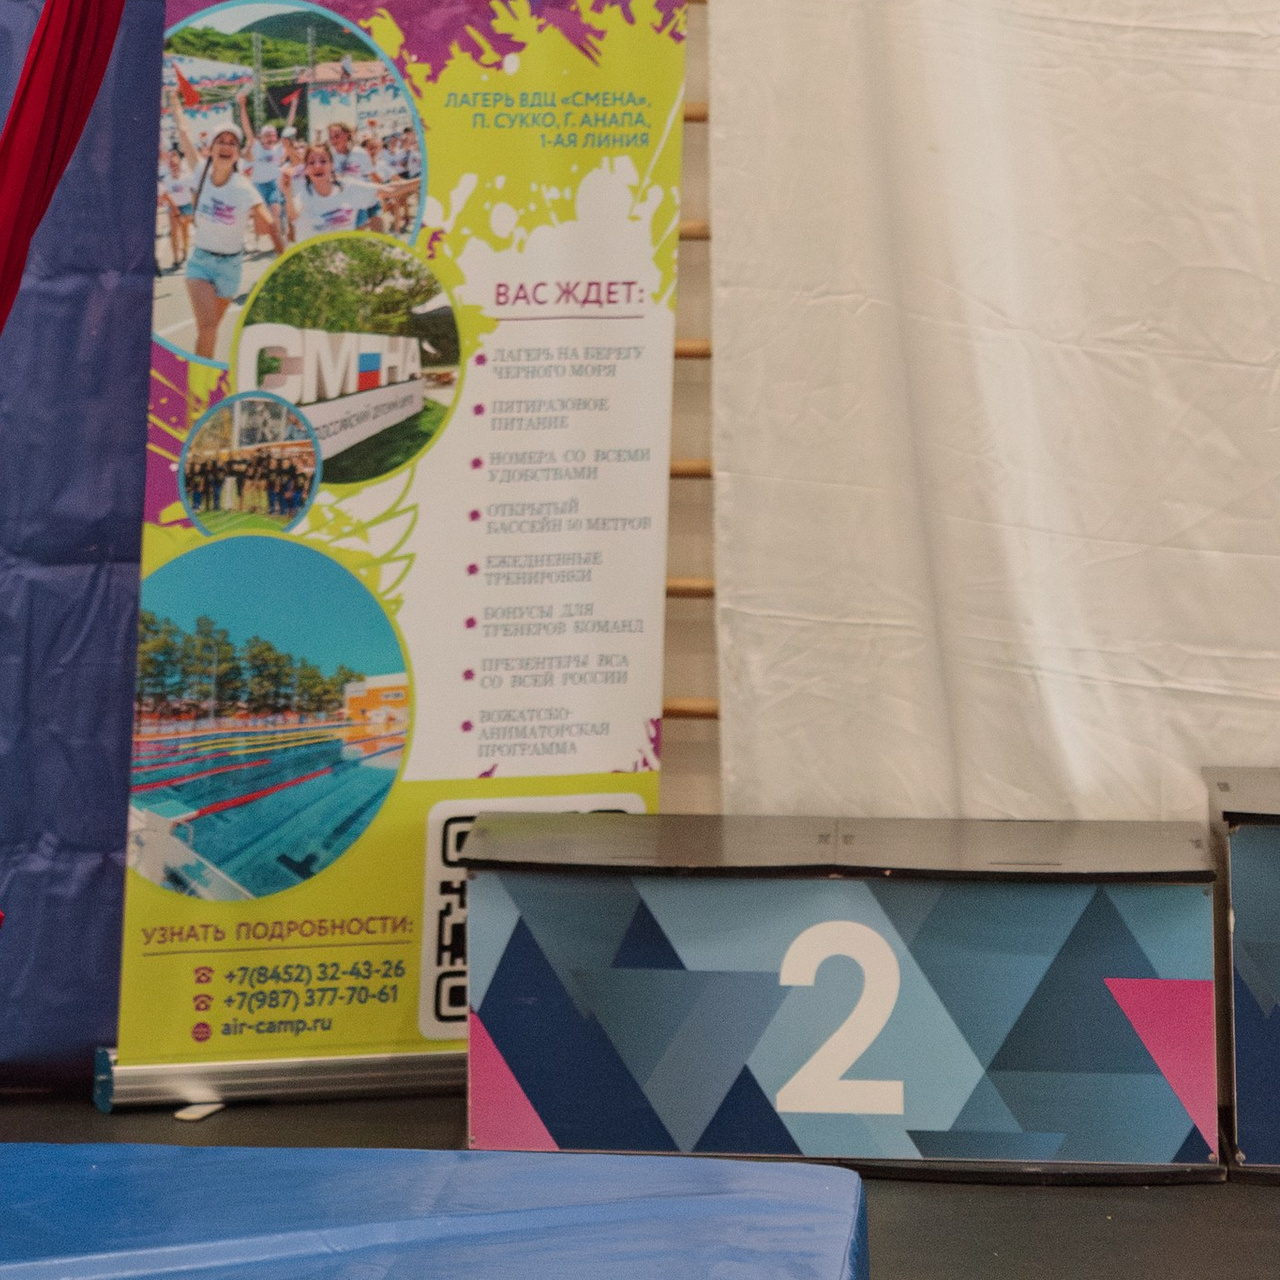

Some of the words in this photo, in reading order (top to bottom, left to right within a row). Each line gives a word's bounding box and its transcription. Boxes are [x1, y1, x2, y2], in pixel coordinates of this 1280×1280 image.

[444, 92, 515, 108] ЛАГЕРЬ
[520, 92, 556, 109] ВДЦ
[561, 91, 652, 108] «СМЕНА»,
[472, 113, 490, 129] П.
[494, 113, 561, 129] СУККО,
[580, 111, 652, 129] АНАПА,
[540, 134, 577, 149] 1-АЯ
[582, 132, 649, 149] ЛИНИЯ
[495, 282, 548, 306] ВАС
[556, 281, 645, 308] ЖДЕТ:
[492, 348, 554, 362] ЛАГЕРЬ
[557, 347, 579, 361] НА
[583, 346, 645, 361] БЕРЕГУ
[492, 365, 566, 379] ЧЕРНОГО
[570, 365, 617, 378] МОРЯ
[490, 416, 569, 431] ПИТАНИЕ
[488, 451, 557, 466] НОМЕРА
[562, 450, 586, 463] СО
[593, 448, 651, 463] ВСЕМИ
[487, 467, 599, 483] УДОБСТВАМИ
[486, 498, 580, 517] ОТКРЫТЫЙ
[486, 516, 562, 535] БАССЕЙН
[586, 517, 652, 531] МЕТРОВ
[484, 569, 592, 586] ТРЕНИРОВКИ
[483, 605, 553, 620] БОНУСЫ
[562, 603, 594, 617] ДЛЯ
[483, 622, 567, 637] ТРЕНЕРОВ
[573, 620, 644, 634] КОМАНД
[479, 676, 503, 689] СО
[510, 671, 554, 688] ВСЕЙ
[562, 671, 628, 686] РОССИИ
[477, 723, 610, 740] АНИМАТОРСКАЯ
[477, 742, 577, 758] ПРОГРАММА
[141, 923, 226, 945] УЗНАТЬ
[235, 915, 414, 942] ПОДРОБНОСТИ:
[225, 964, 312, 989] +7(8452)
[317, 960, 406, 982] 32-43-26
[224, 989, 299, 1014] +7(987)
[304, 984, 398, 1007] 377-70-61
[776, 920, 904, 1115] 2
[221, 1018, 332, 1037] air-camp.ru
